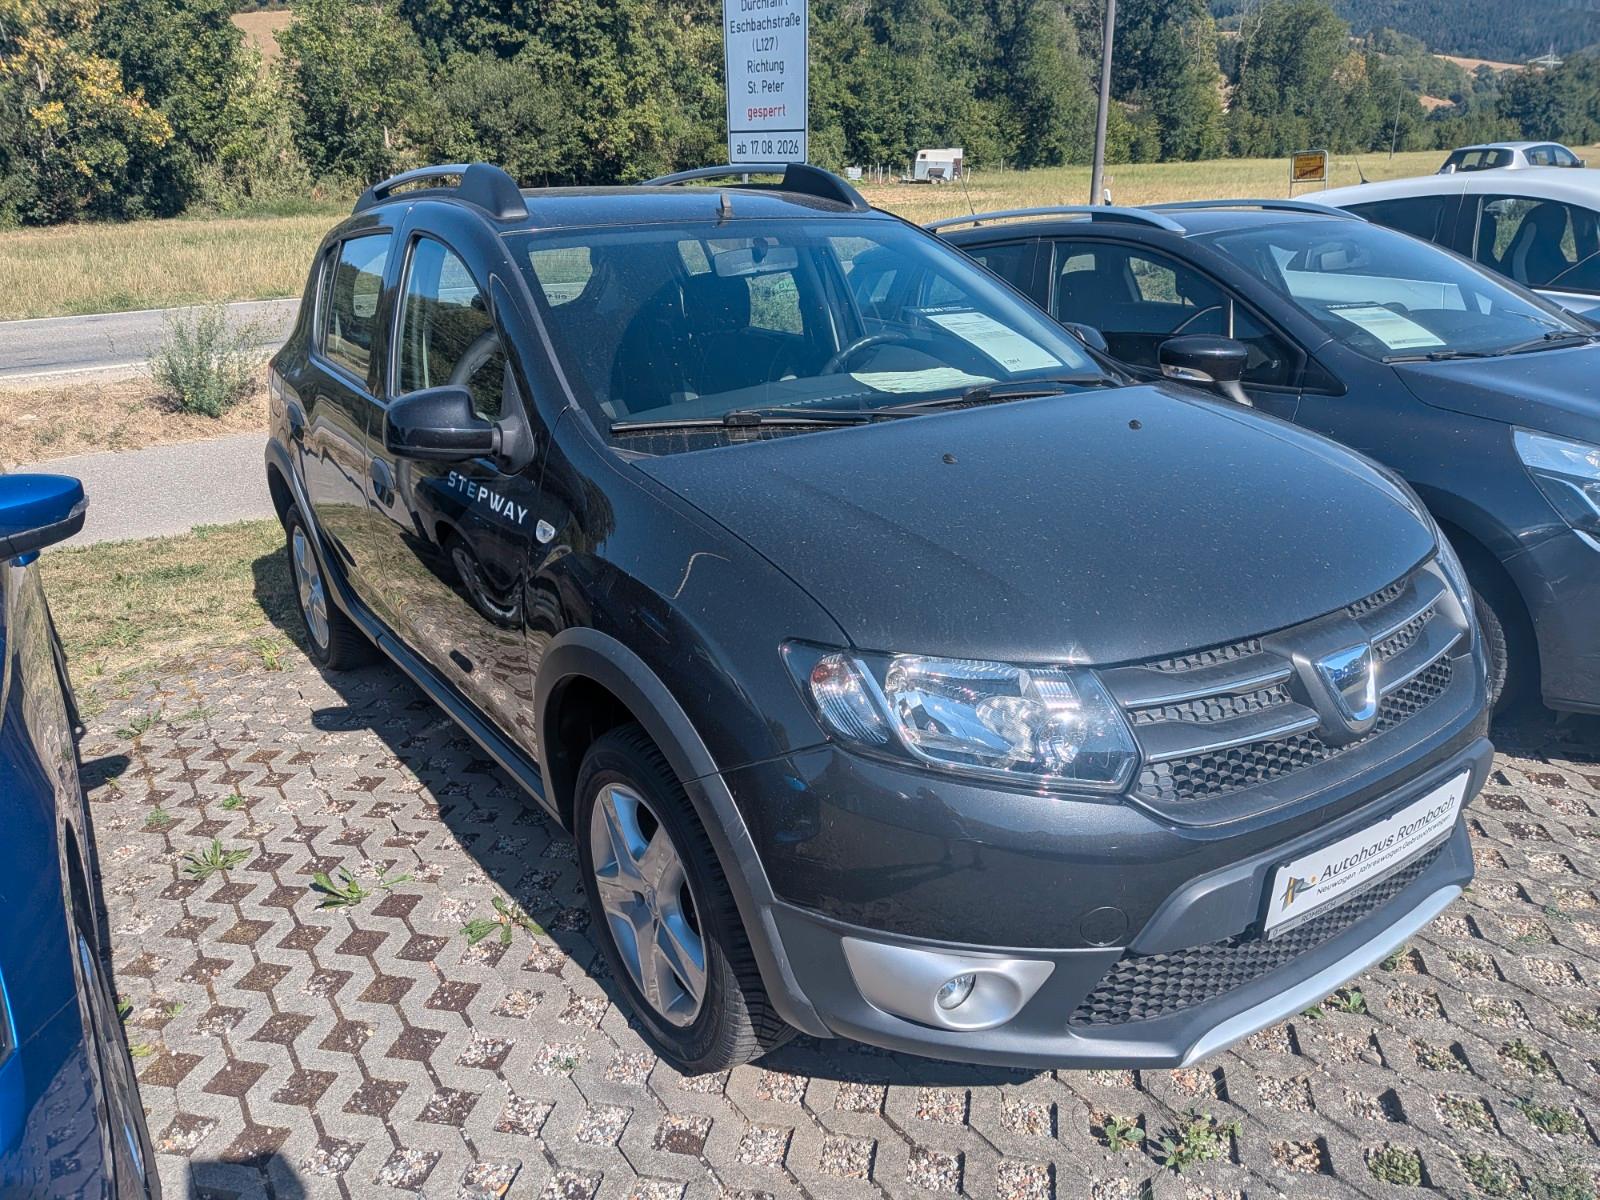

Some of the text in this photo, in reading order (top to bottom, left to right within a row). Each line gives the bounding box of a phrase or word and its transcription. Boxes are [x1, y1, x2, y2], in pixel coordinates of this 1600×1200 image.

[730, 12, 801, 34] Eschbachstraße
[752, 36, 779, 54] (L127)
[747, 59, 785, 74] Richtung
[747, 79, 785, 94] St. Peter
[747, 103, 786, 121] gesperrt
[736, 141, 747, 155] ab
[447, 470, 528, 525] STEPWAY
[1319, 833, 1395, 882] Autohaus
[1396, 794, 1456, 842] Rombach
[1316, 871, 1357, 896] Neuwagen
[1358, 846, 1402, 874] Jahreswagen
